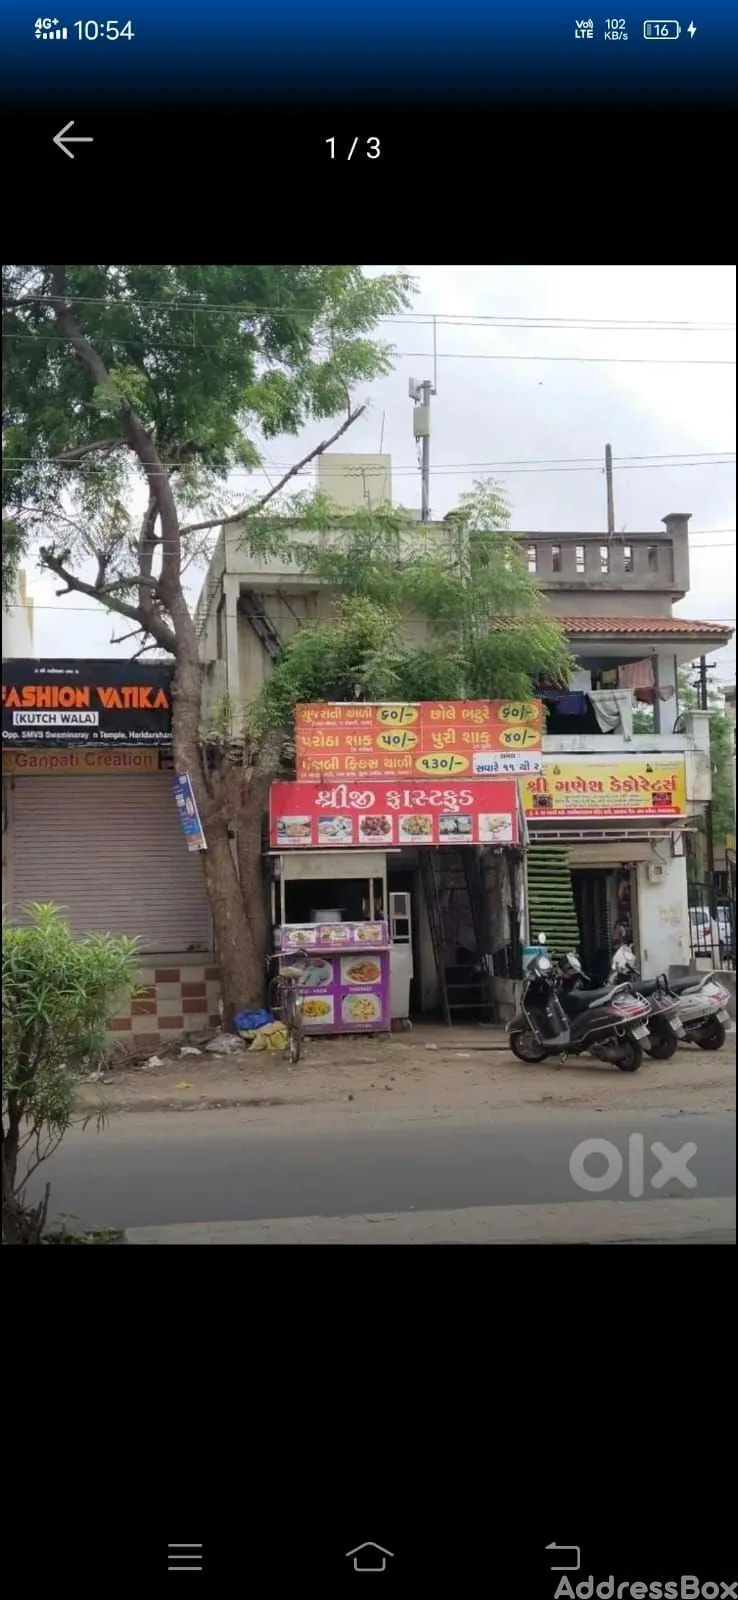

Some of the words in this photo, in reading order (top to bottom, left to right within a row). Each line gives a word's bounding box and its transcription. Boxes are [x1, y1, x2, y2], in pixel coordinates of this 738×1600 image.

[97, 686, 169, 708] VATIKA
[15, 713, 57, 725] (KUTCH
[60, 713, 97, 725] WALA)
[301, 707, 342, 723] ગુજરાતી
[346, 706, 373, 719] થાળી
[429, 704, 456, 720] છોલે
[2, 731, 19, 740] Opp.
[22, 731, 43, 739] SMVS
[302, 731, 339, 748] પરોઠા
[345, 734, 373, 747] શાક
[431, 728, 456, 750] પુરી
[15, 752, 79, 770] Ganpati
[81, 752, 153, 766] Creation
[384, 754, 413, 768] થાળી
[475, 762, 499, 773] સવારે
[526, 776, 549, 793] શ્રી
[554, 776, 604, 793] ગણેશ
[314, 783, 376, 809] શ્રીજી
[386, 788, 475, 812] ફાસ્ટફુડ
